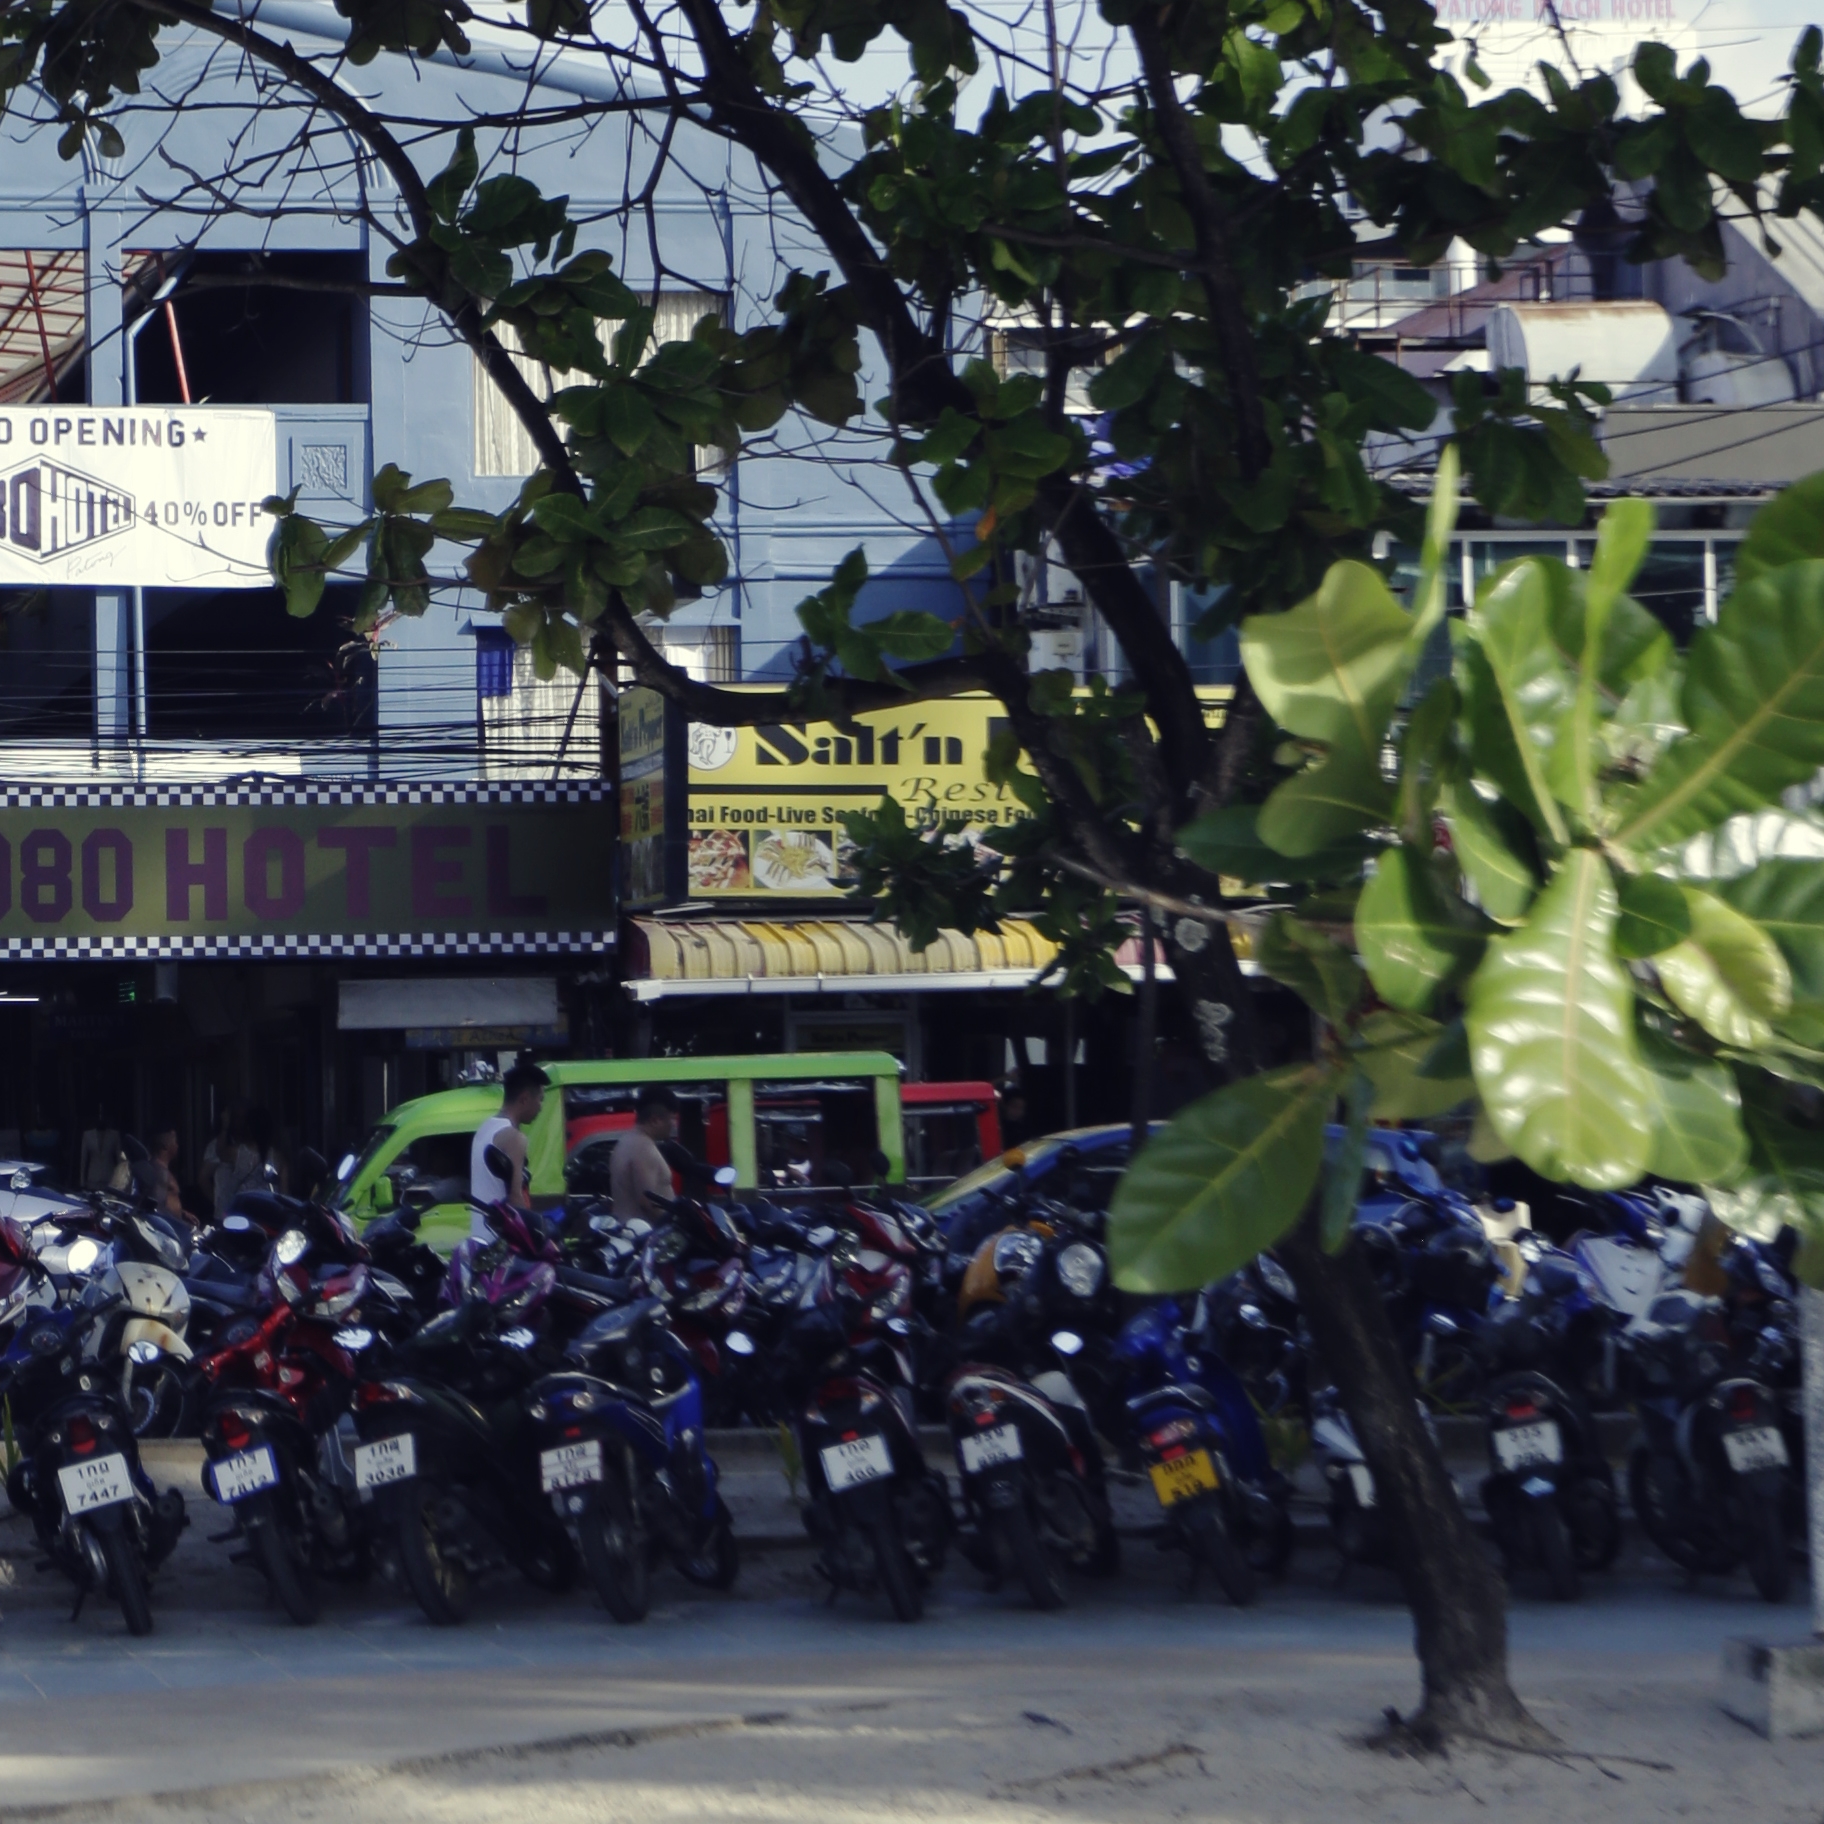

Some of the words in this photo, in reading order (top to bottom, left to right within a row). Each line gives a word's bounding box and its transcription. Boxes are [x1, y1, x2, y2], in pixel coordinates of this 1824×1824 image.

[29, 416, 186, 449] OPENING
[41, 461, 133, 553] HOTEL
[753, 723, 963, 766] Salt'n
[165, 824, 549, 923] HOTEL
[76, 1484, 119, 1507] 7447
